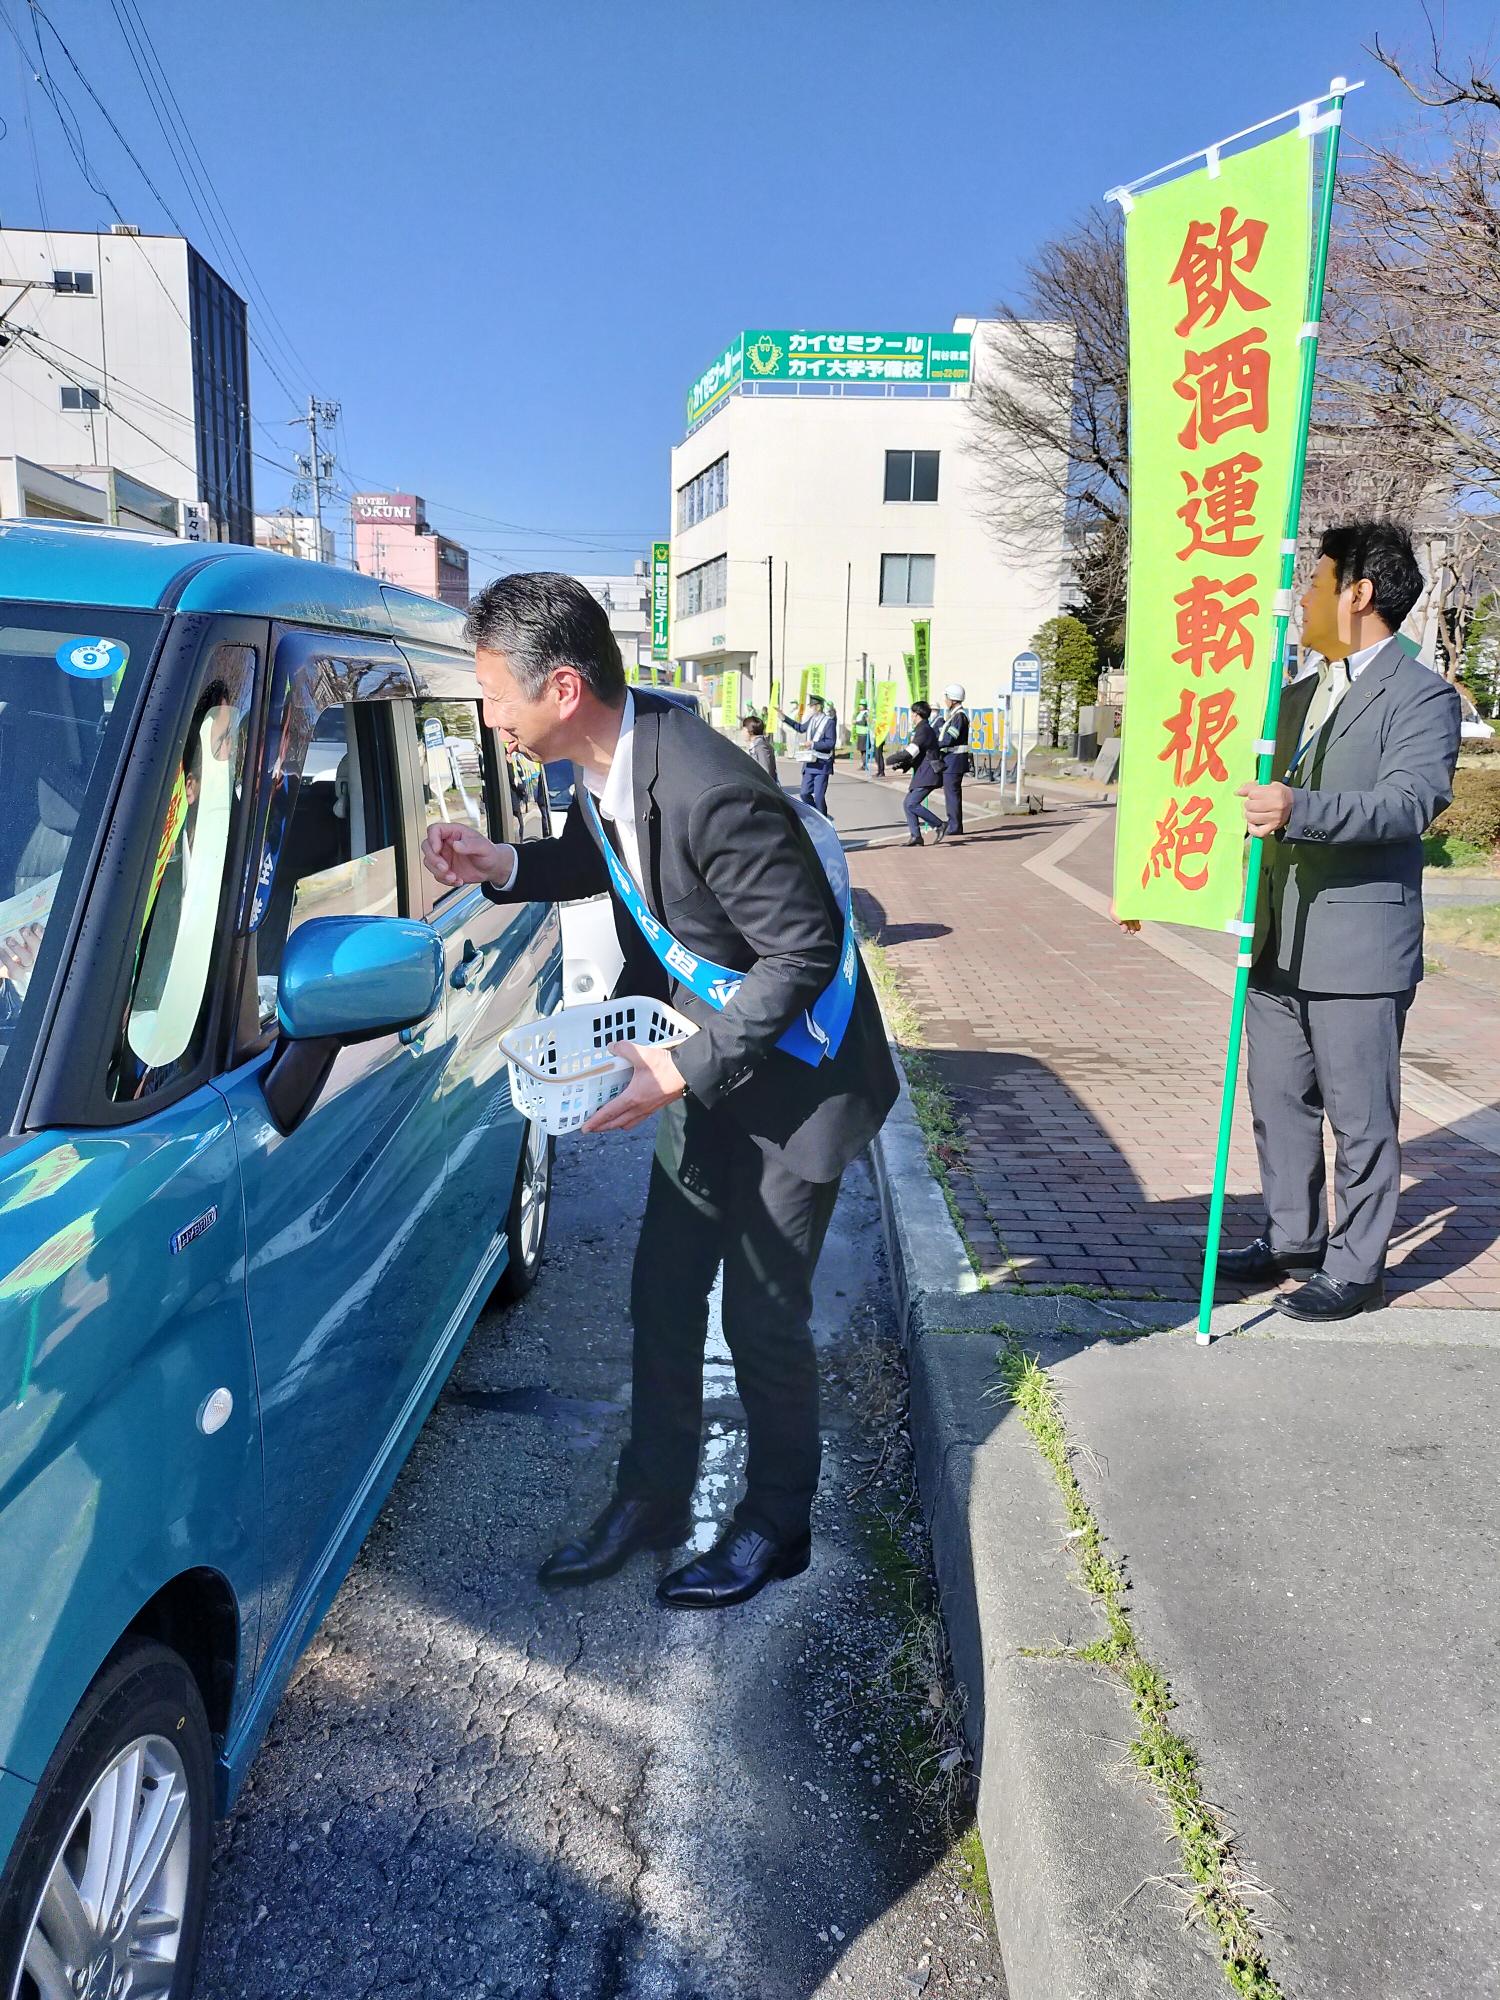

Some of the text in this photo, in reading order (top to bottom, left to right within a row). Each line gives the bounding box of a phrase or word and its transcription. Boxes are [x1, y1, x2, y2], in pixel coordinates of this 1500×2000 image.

[788, 335, 924, 353] カイゼミナール
[787, 359, 924, 379] カイ大学予備校
[1142, 206, 1271, 891] 飲酒運転根絶
[83, 653, 97, 665] 9
[181, 1209, 217, 1247] HYBRID
